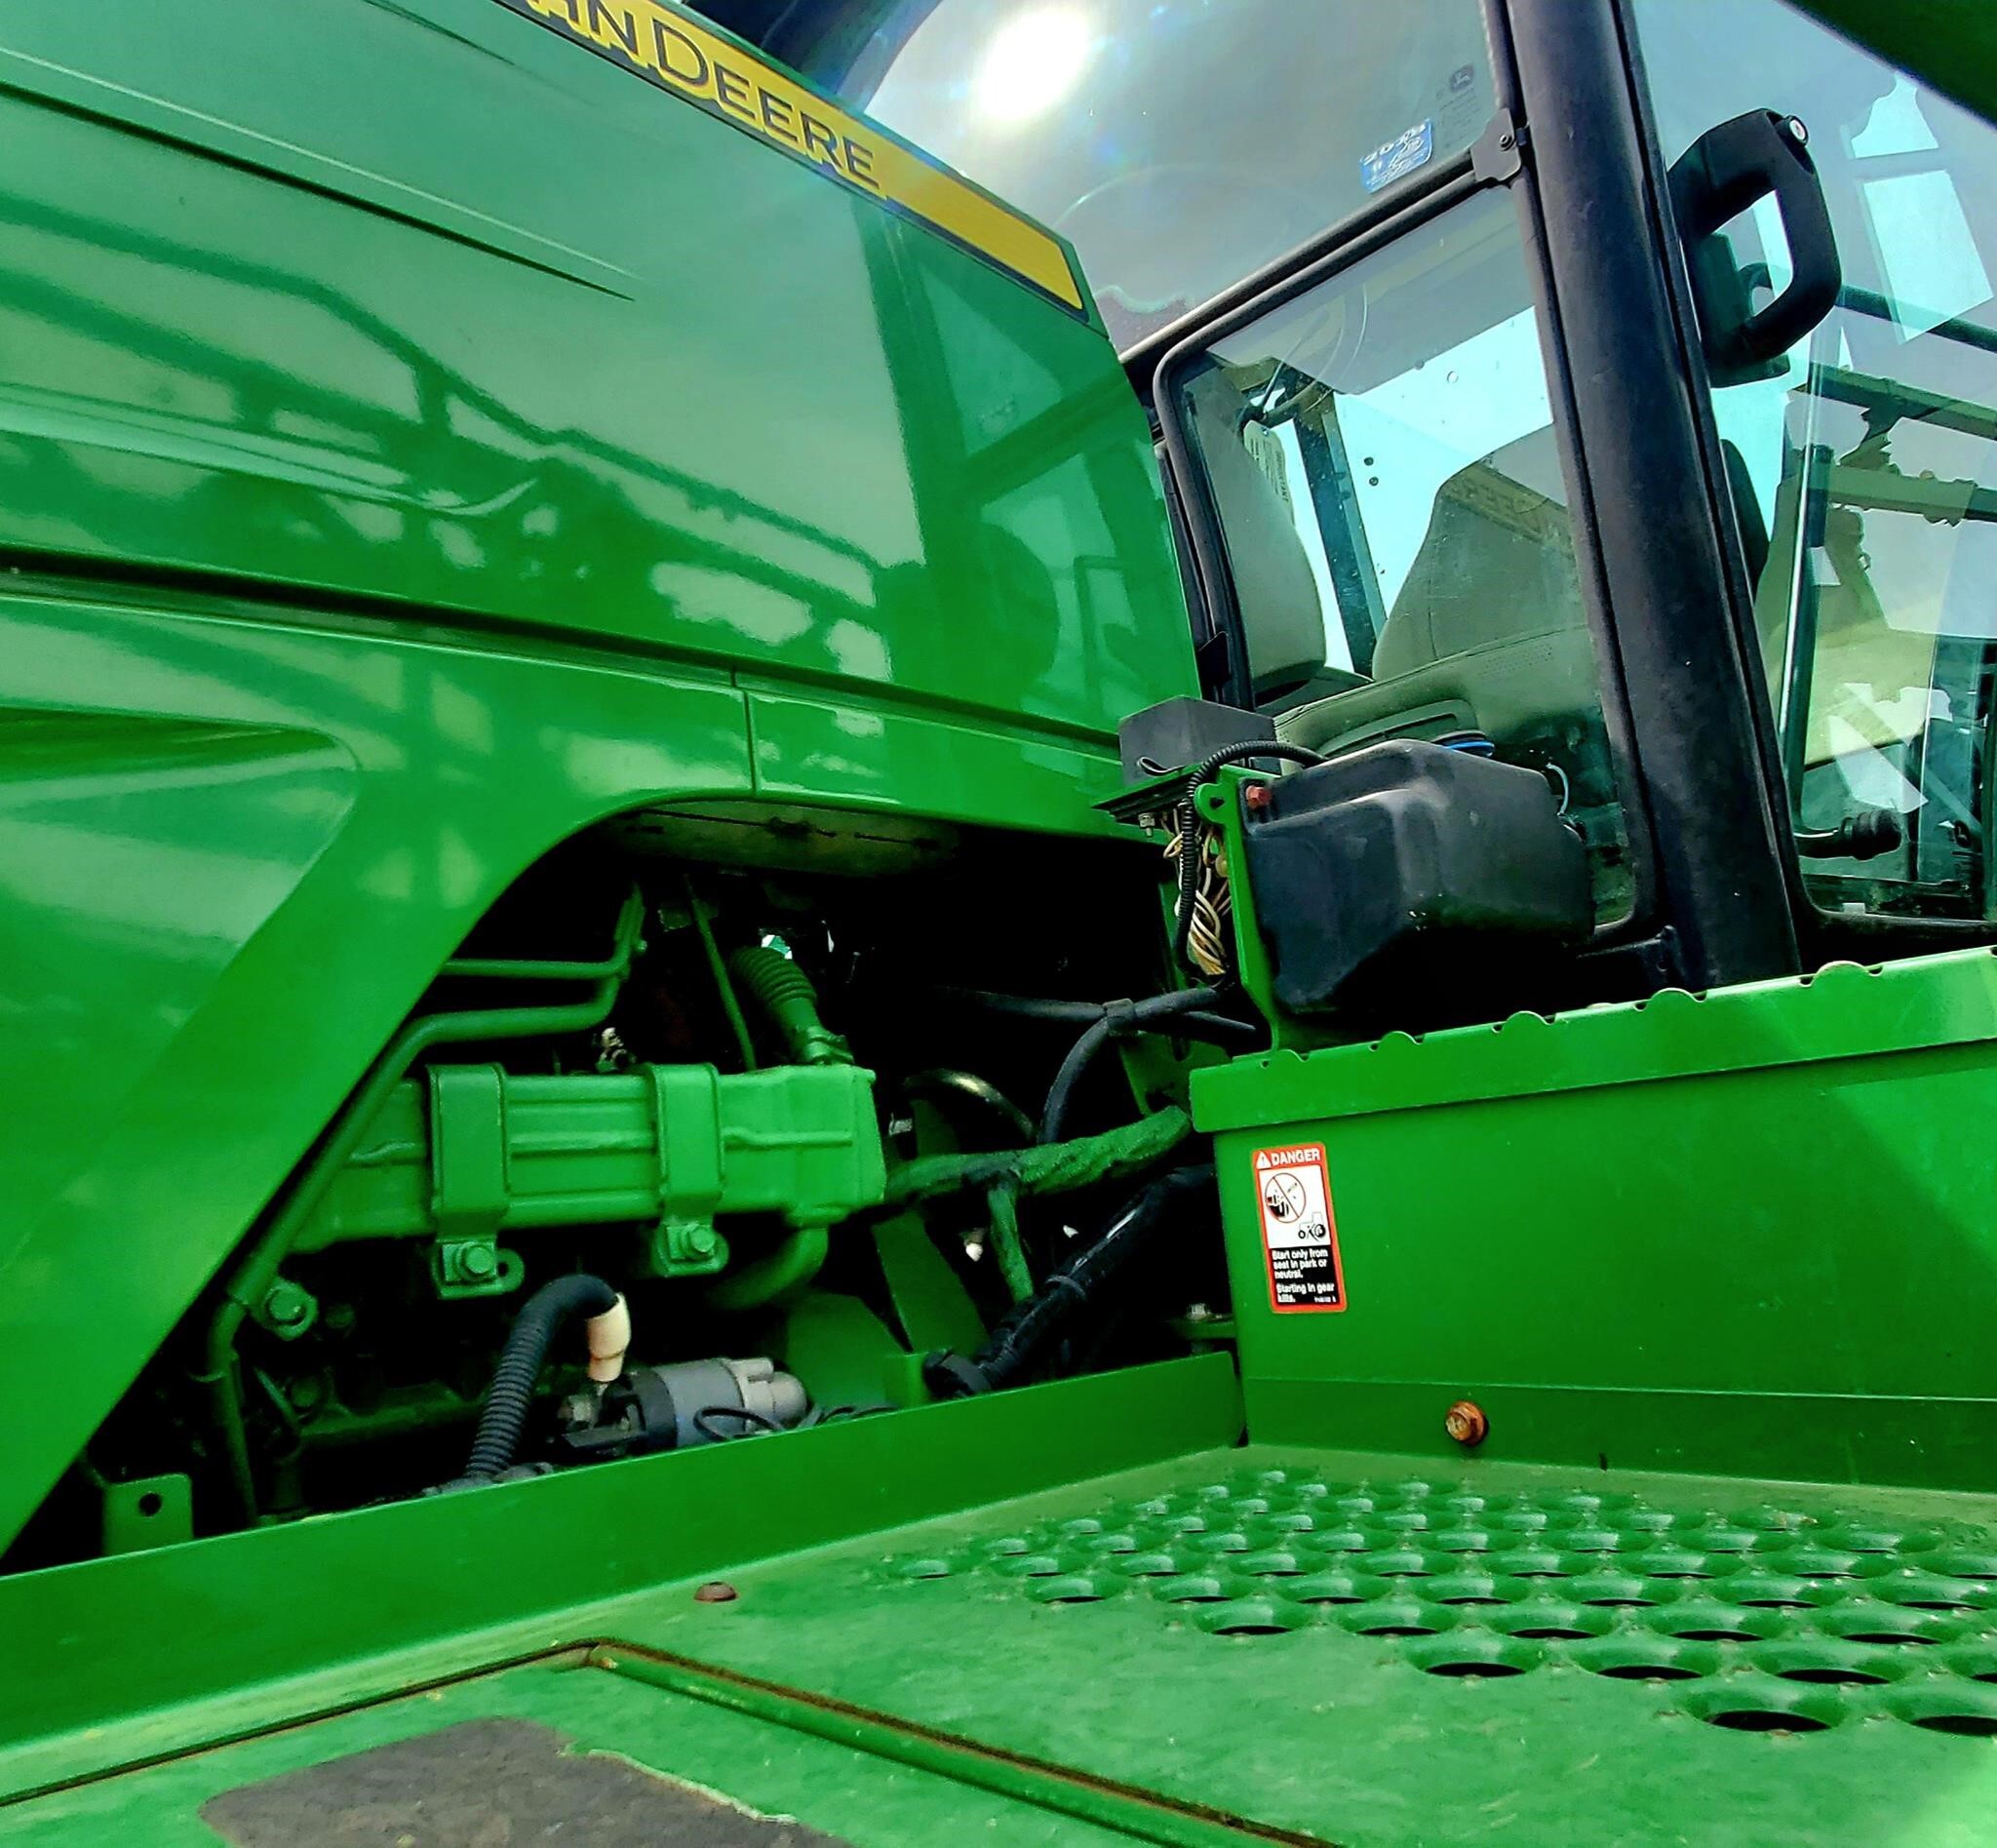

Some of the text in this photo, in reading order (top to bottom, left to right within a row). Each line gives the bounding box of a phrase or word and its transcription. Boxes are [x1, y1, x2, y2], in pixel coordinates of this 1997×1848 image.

[652, 18, 880, 190] DEERE
[1271, 1148, 1320, 1166] DANGER
[1272, 1248, 1328, 1260] Start only from
[1273, 1261, 1289, 1270] seat
[1290, 1260, 1298, 1269] in
[1299, 1259, 1317, 1270] park
[1274, 1270, 1303, 1278] neutral.
[1276, 1283, 1334, 1294] Starting in gear
